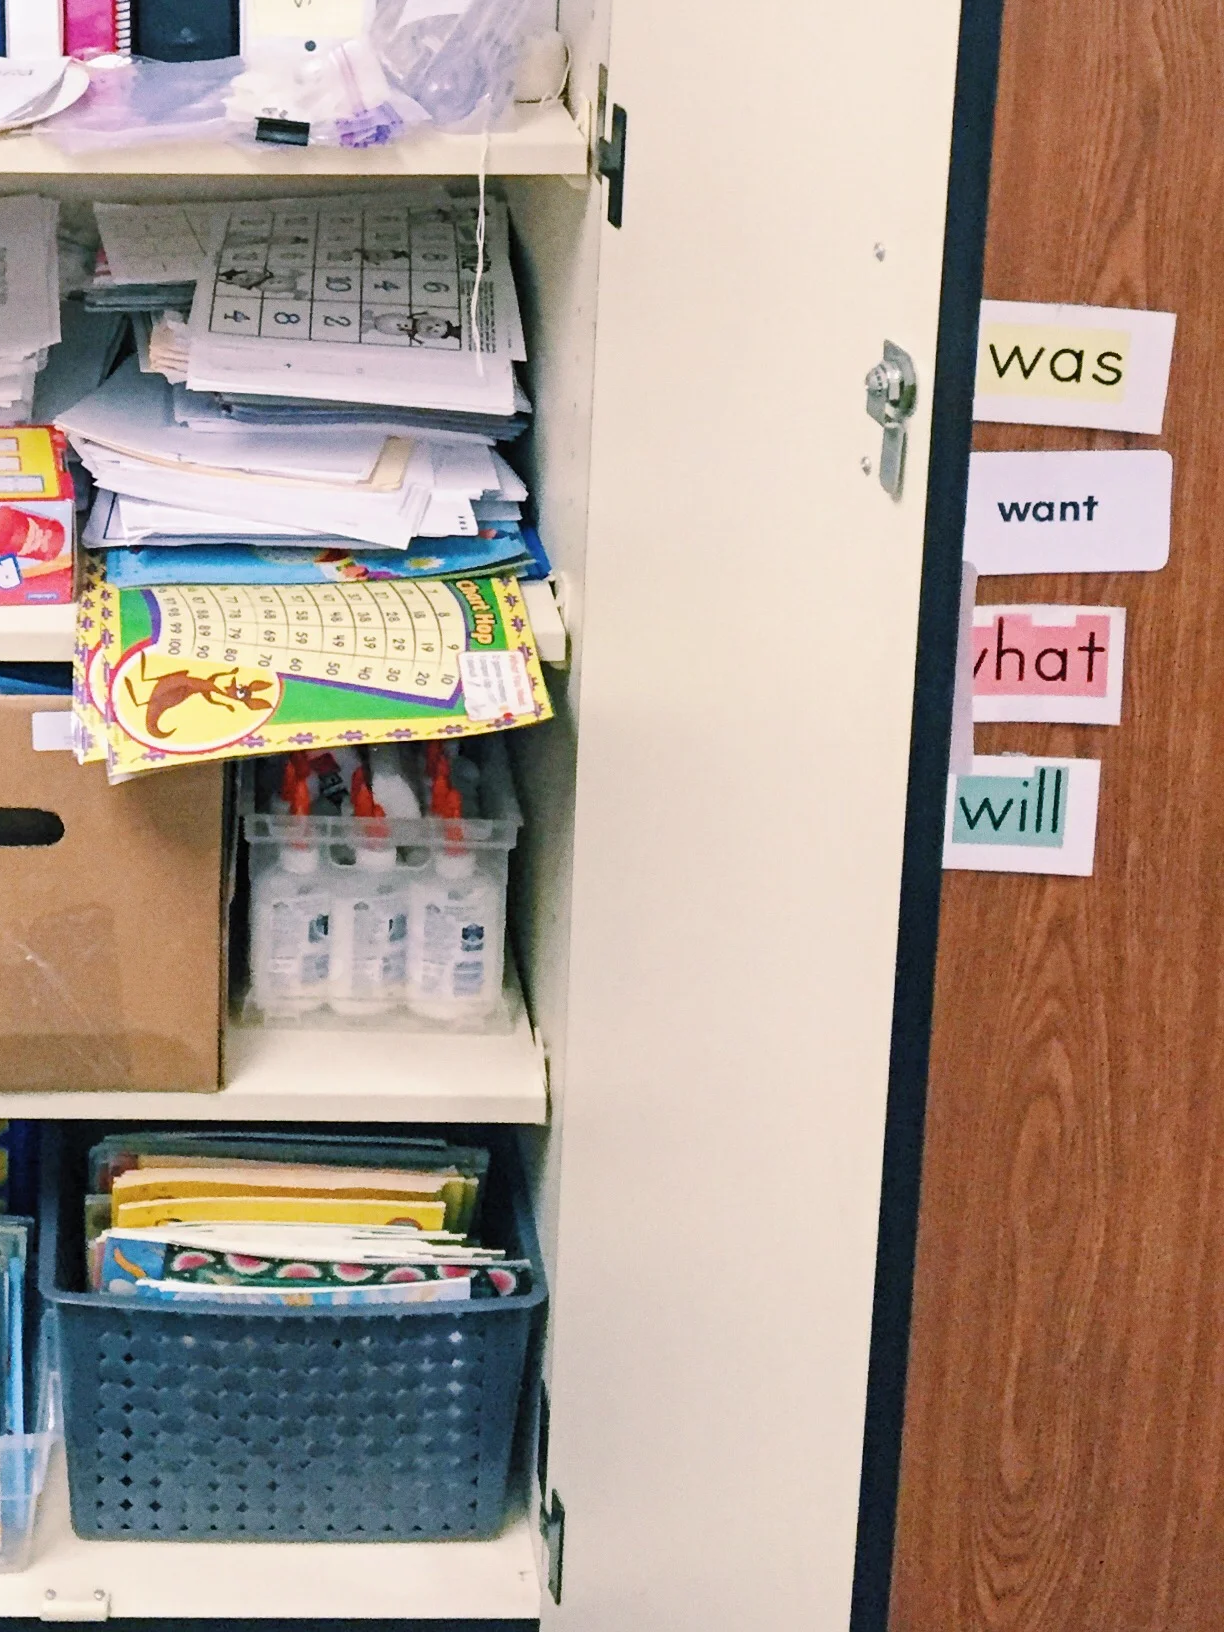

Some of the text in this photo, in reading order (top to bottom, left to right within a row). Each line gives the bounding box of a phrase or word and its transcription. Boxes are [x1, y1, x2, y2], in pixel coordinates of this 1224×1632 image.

[223, 309, 251, 324] 4
[273, 311, 301, 325] 8
[988, 342, 1125, 387] was
[997, 494, 1099, 523] want
[170, 622, 182, 635] 99
[199, 625, 211, 637] 89
[228, 627, 242, 640] 79
[470, 612, 496, 645] Hop
[264, 630, 276, 643] 69
[295, 631, 308, 645] 59
[332, 634, 345, 647] 49
[363, 636, 376, 649] 39
[168, 638, 182, 656] 100
[197, 644, 210, 659] 90
[392, 638, 405, 652] 29
[421, 642, 434, 653] 19
[447, 643, 459, 651] 9
[224, 648, 238, 662] 80
[258, 653, 273, 667] 70
[289, 657, 303, 672] 60
[326, 661, 341, 676] 50
[358, 666, 373, 681] 40
[386, 668, 401, 682] 30
[415, 671, 430, 686] 20
[441, 673, 456, 685] 10
[959, 769, 1063, 835] will
